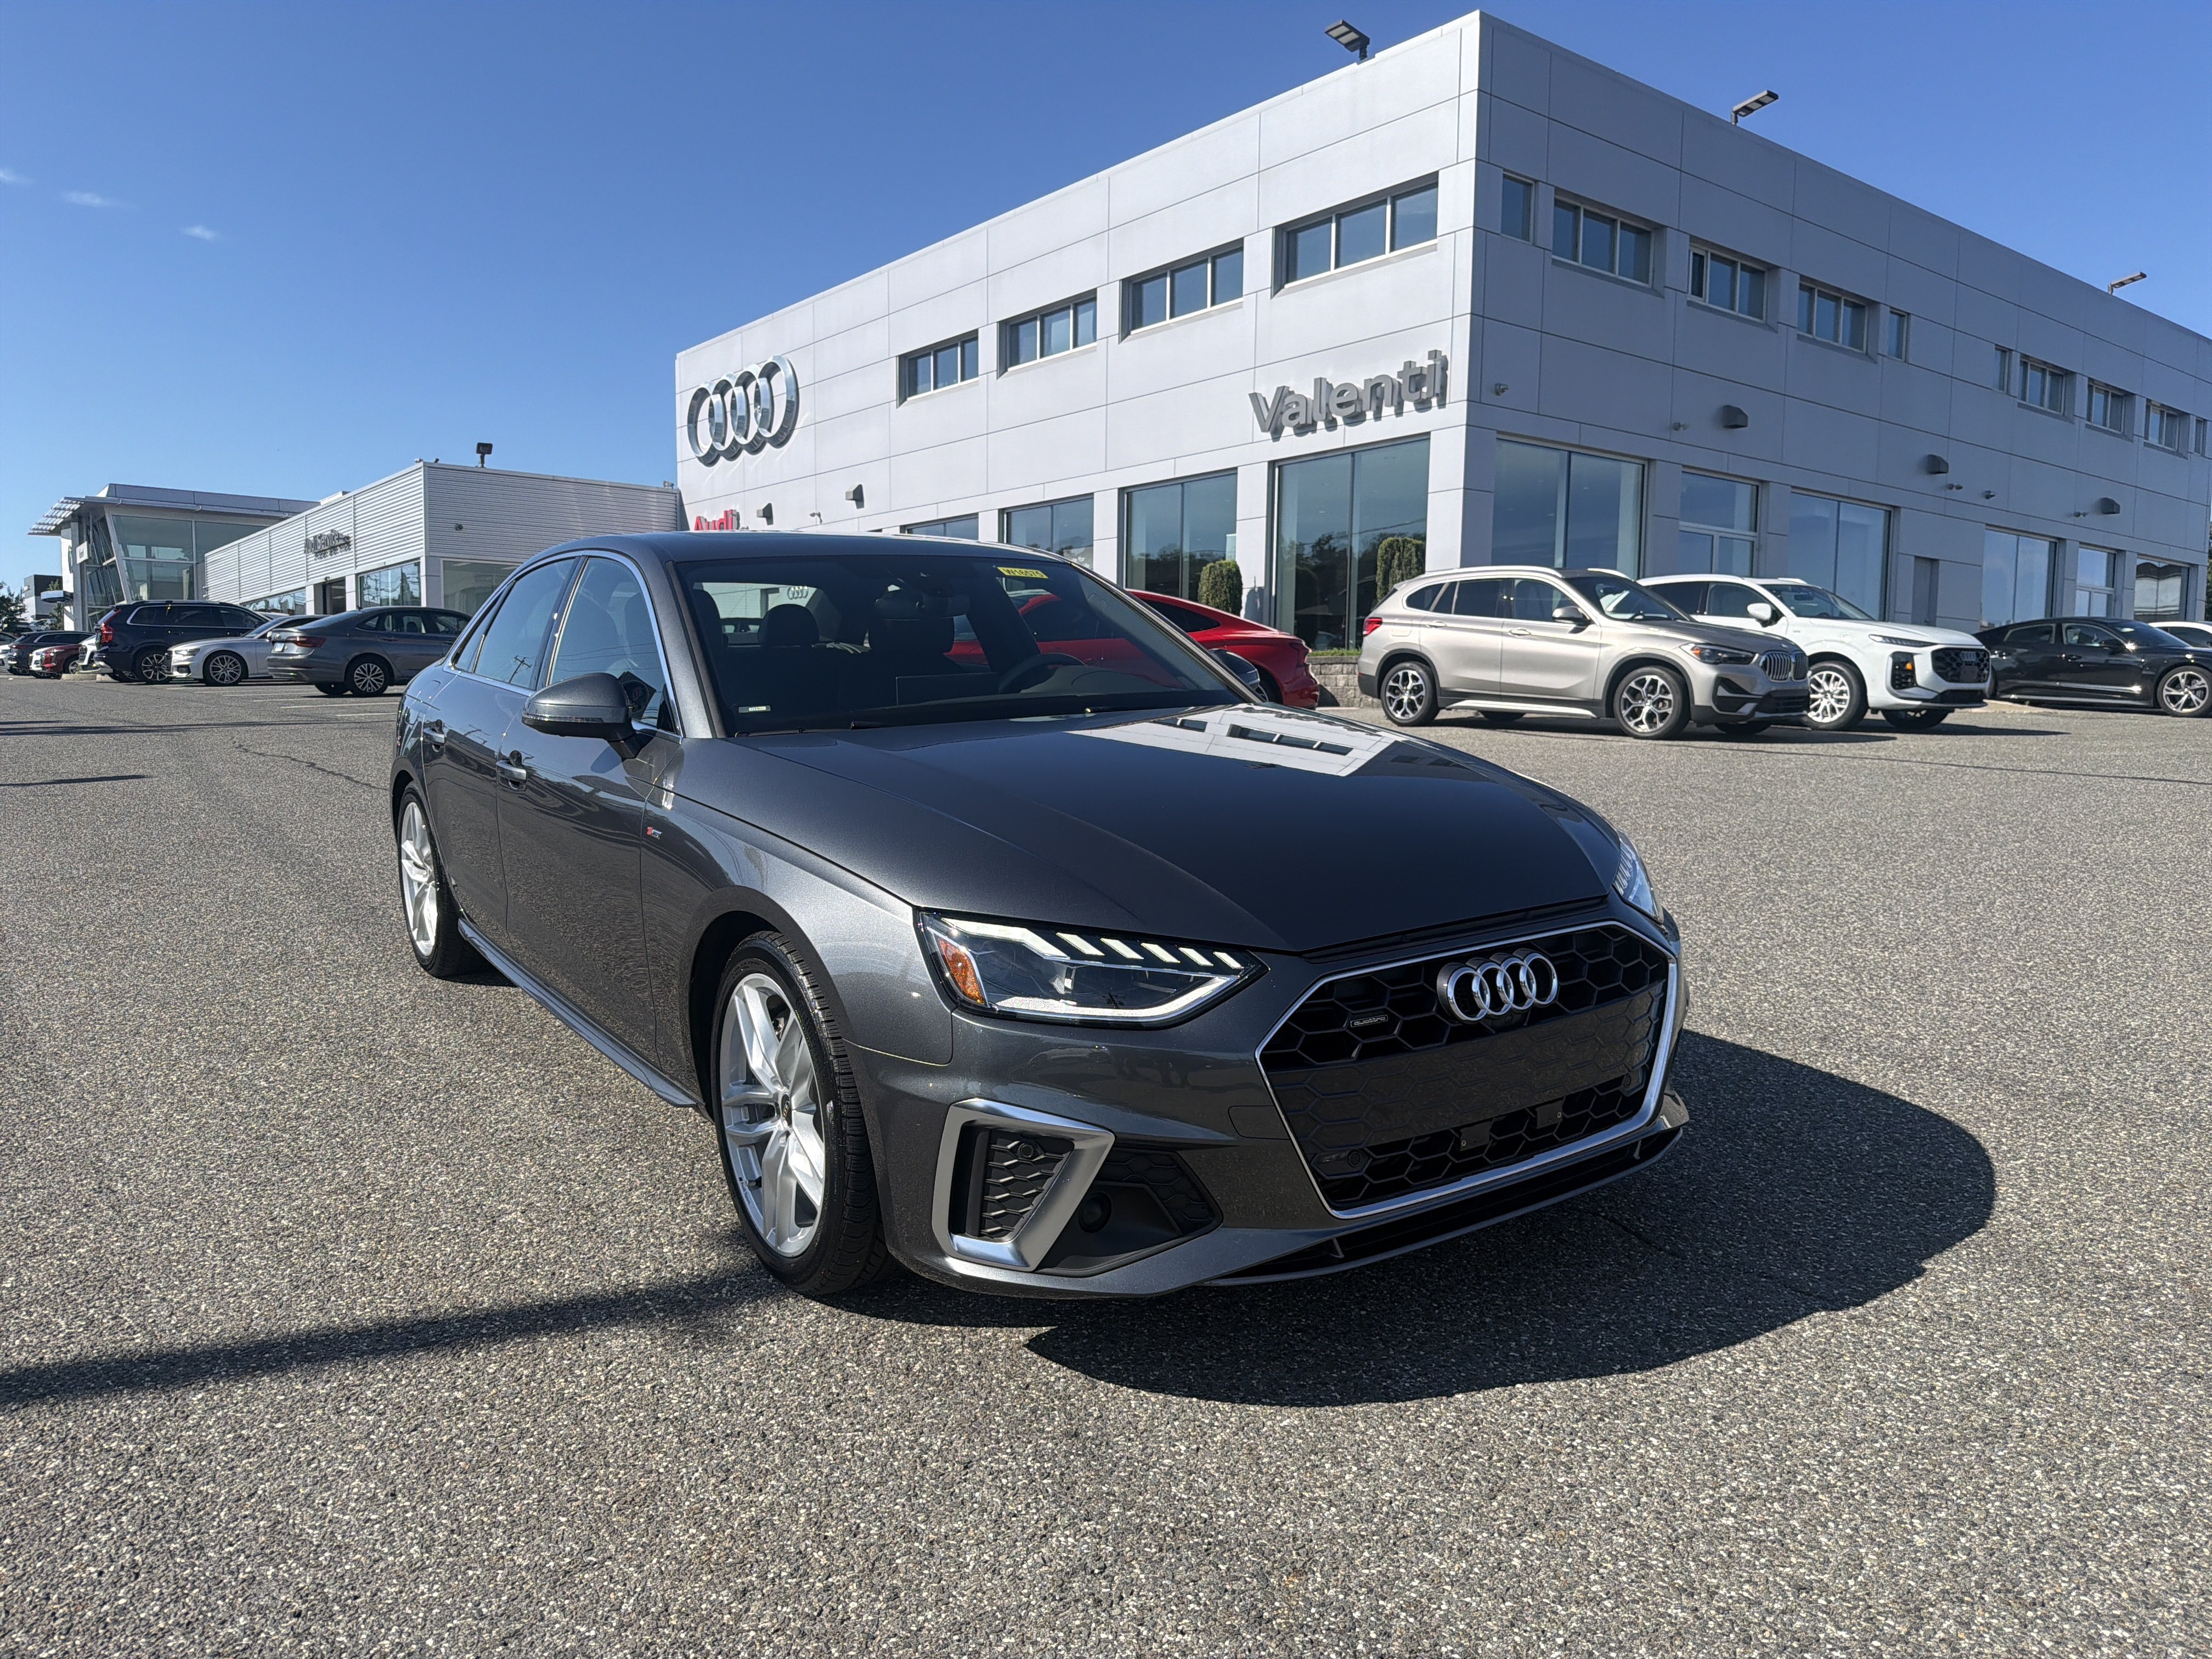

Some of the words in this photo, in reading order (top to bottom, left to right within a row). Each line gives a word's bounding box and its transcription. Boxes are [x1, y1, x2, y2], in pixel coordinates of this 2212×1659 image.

[1248, 349, 1445, 433] Valenti
[304, 535, 317, 554] Audi
[316, 531, 339, 549] Service
[1353, 1016, 1386, 1025] quattro
